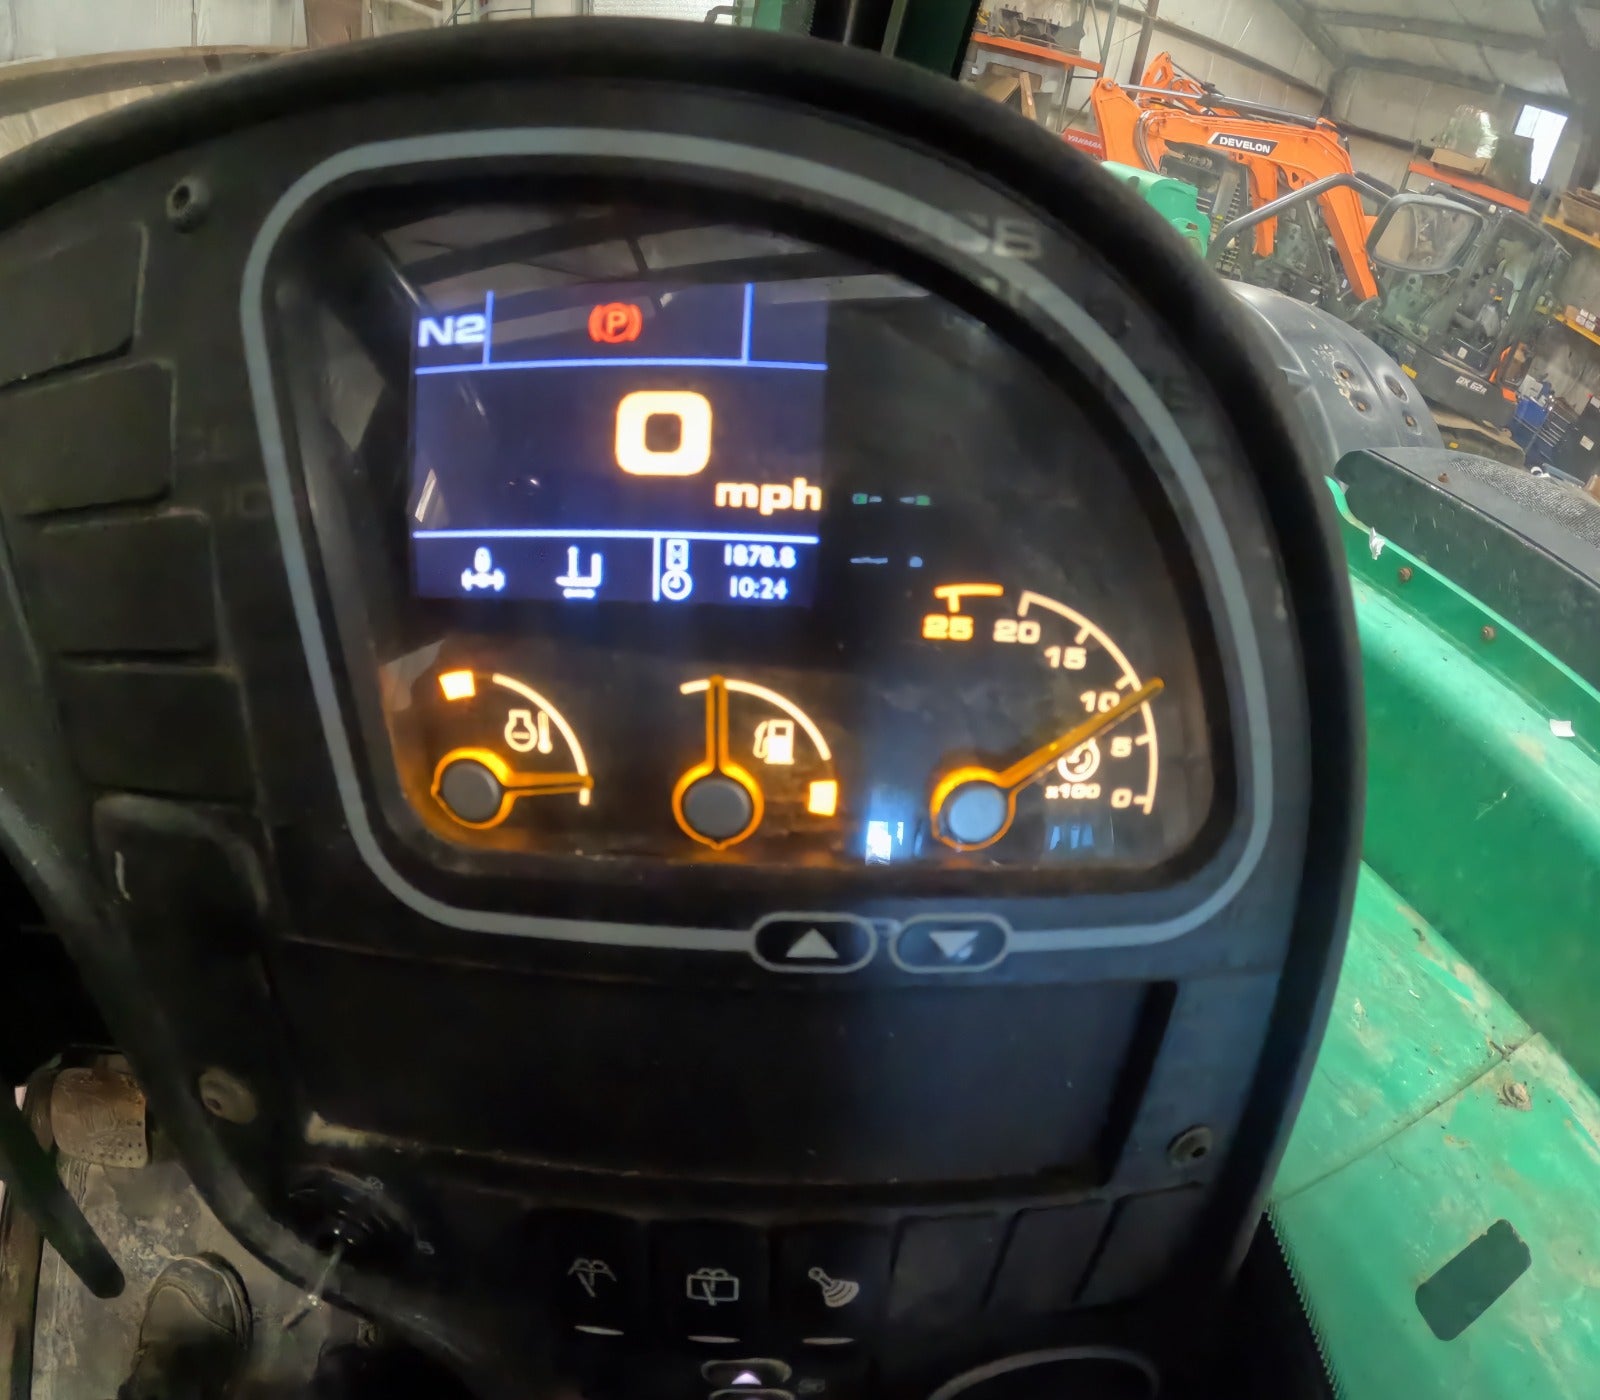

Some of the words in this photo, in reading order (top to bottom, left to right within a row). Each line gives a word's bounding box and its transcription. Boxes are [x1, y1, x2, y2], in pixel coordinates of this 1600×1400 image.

[1219, 136, 1271, 154] DEVELON
[418, 315, 486, 347] N2
[615, 391, 712, 476] 0
[715, 478, 822, 515] mph
[730, 576, 788, 600] 10:24
[922, 614, 974, 641] 25
[993, 619, 1041, 644] 20
[1044, 646, 1087, 670] 15
[1080, 691, 1120, 712] 10
[1111, 737, 1132, 757] 5
[1111, 788, 1132, 809] 0
